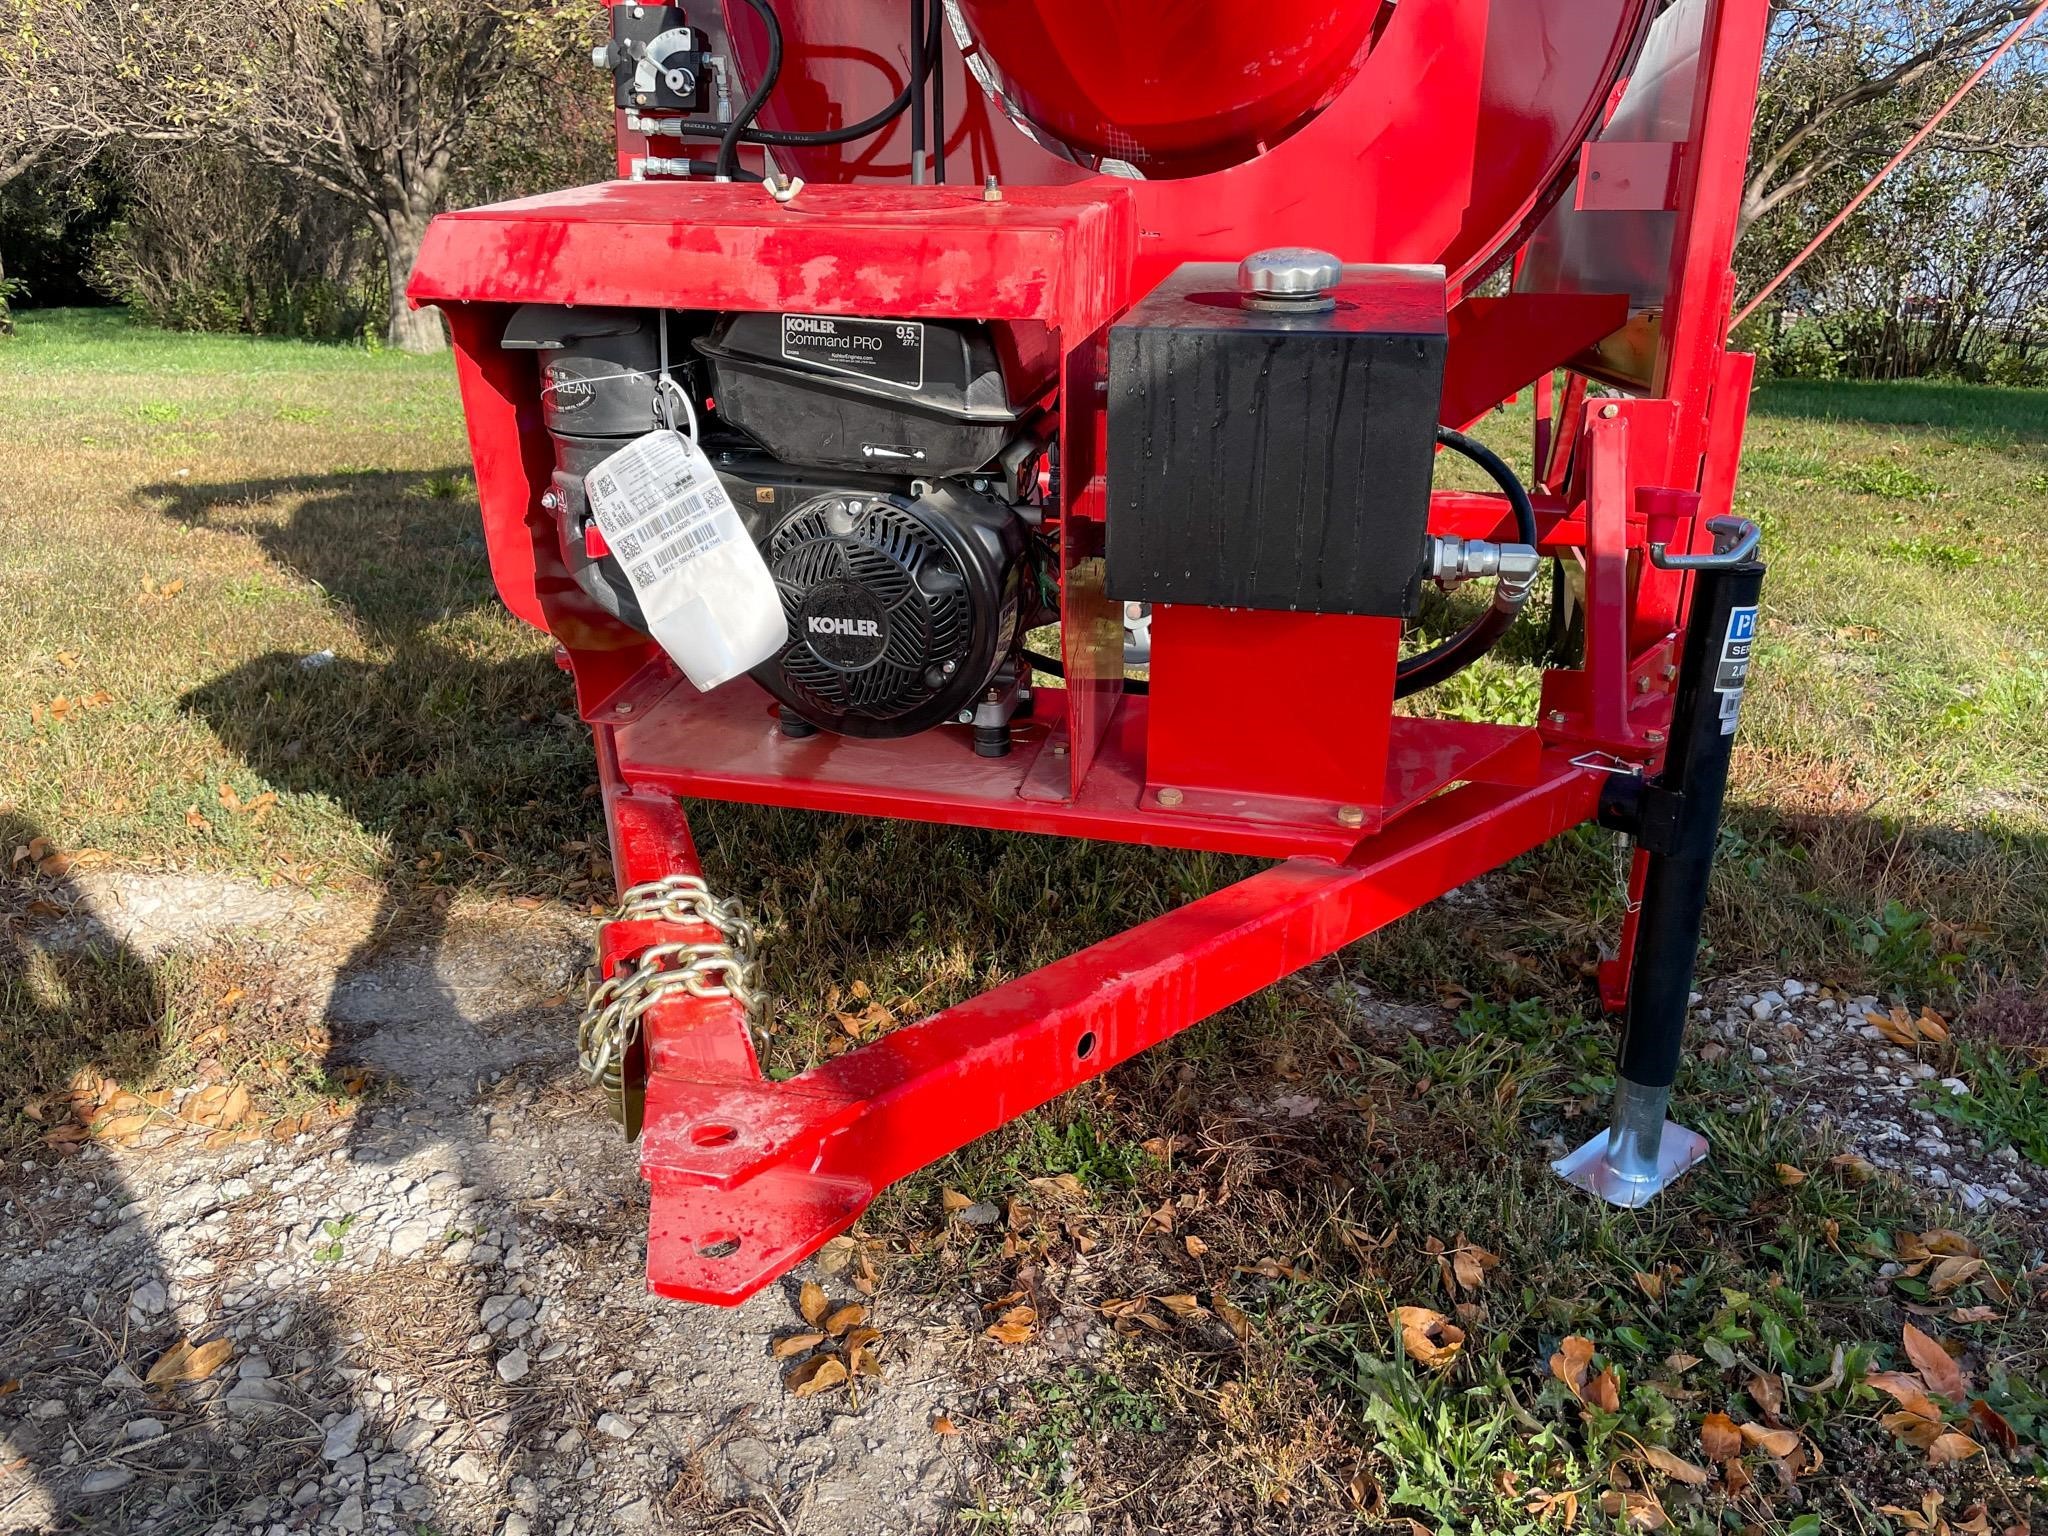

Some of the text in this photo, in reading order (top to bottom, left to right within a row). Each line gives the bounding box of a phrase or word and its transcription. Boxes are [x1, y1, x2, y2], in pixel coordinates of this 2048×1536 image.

[786, 318, 836, 334] KOHLER
[896, 326, 915, 340] 9.5
[785, 331, 883, 350] Command PRO
[808, 616, 882, 637] KOHLER
